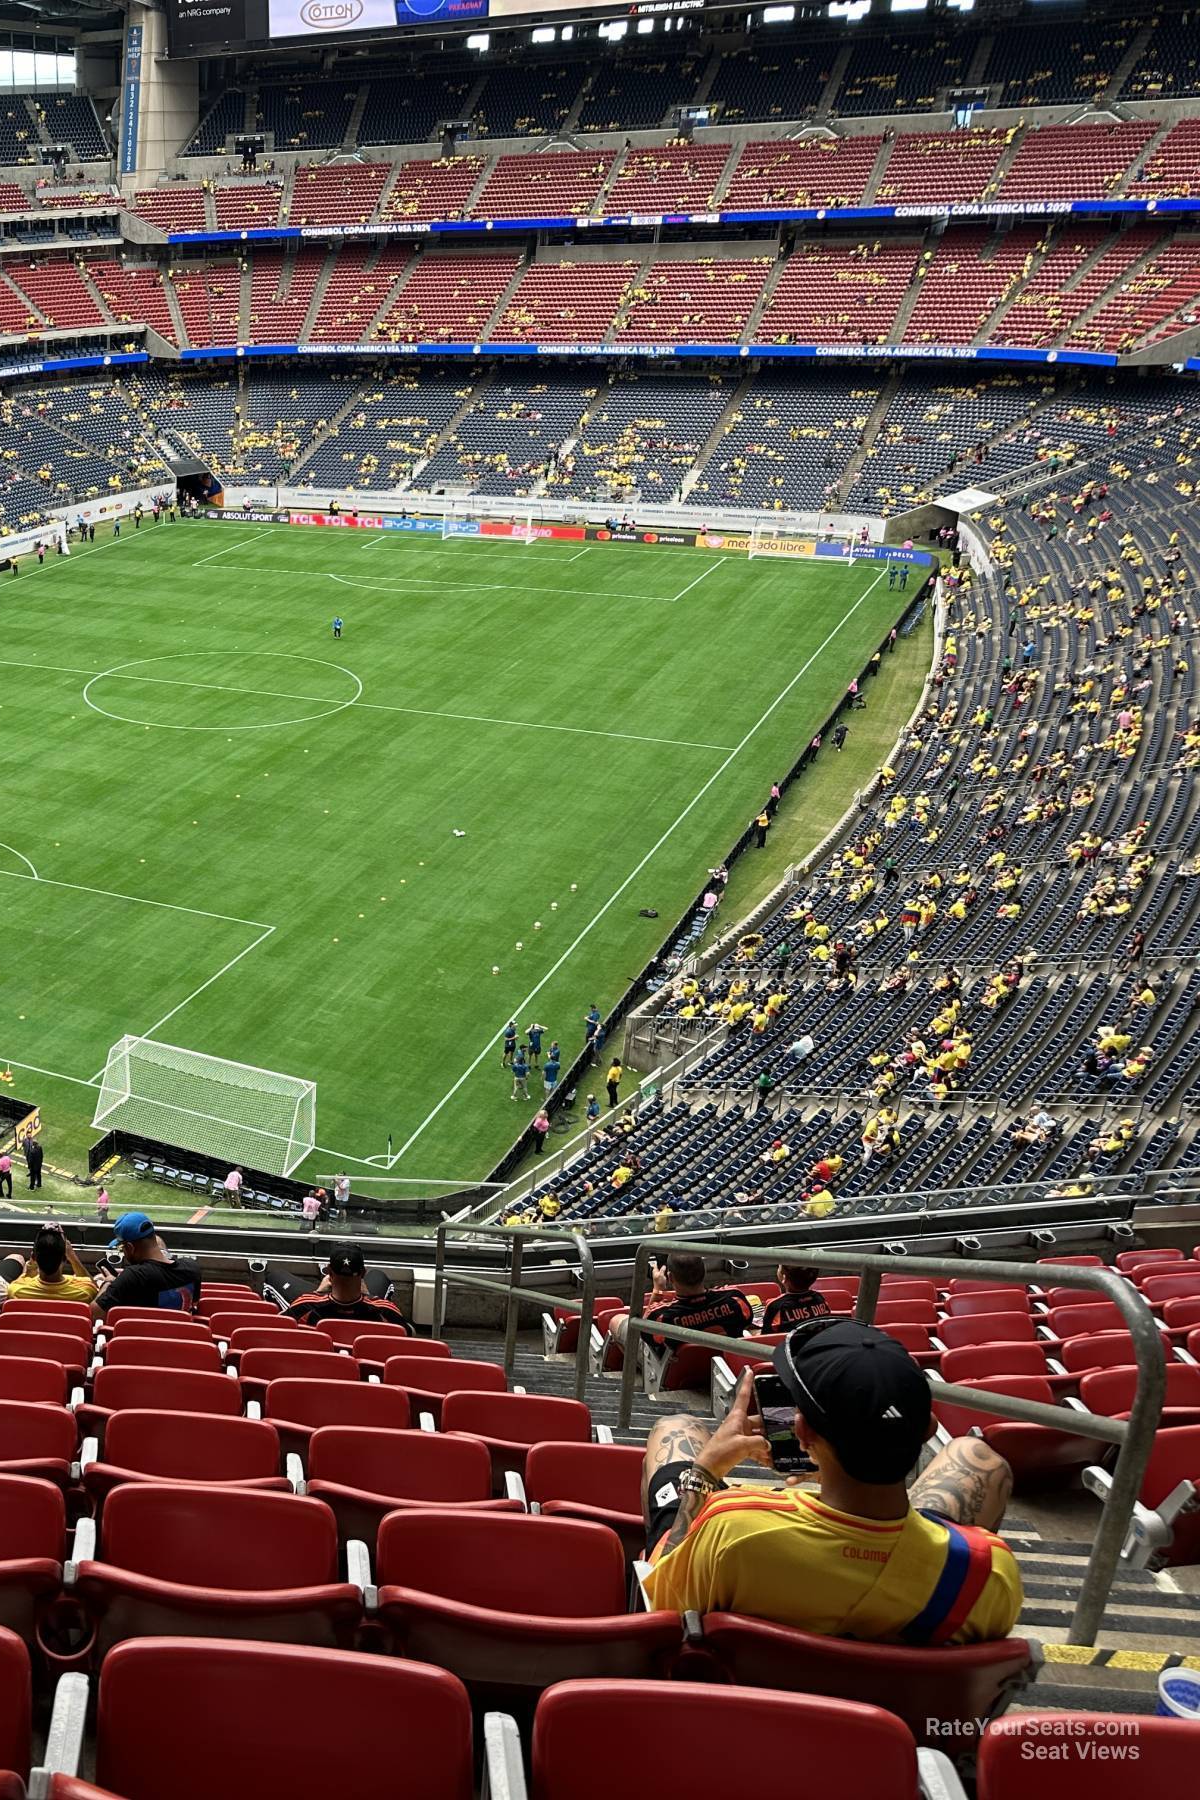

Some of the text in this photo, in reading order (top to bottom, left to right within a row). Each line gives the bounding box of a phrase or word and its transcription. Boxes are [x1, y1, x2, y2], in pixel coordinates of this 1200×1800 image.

[187, 8, 201, 17] NRG
[202, 7, 231, 16] company
[895, 203, 1073, 217] CONMEBOL COPA AMERICA USA 2024
[301, 227, 343, 236] CONMEBOL
[344, 226, 365, 235] COPA
[365, 225, 397, 234] AMERICA
[412, 224, 430, 232] 2024
[537, 346, 675, 354] CONMEBOL COPA AMERICA USA 2024
[816, 347, 977, 357] CONMEBOL COPA AMERICA USA 2024
[222, 511, 251, 521] ABSOLUT
[251, 513, 273, 522] SPORT
[290, 514, 316, 525] TCL
[323, 515, 349, 526] TCL
[356, 517, 383, 528] TCL
[384, 520, 413, 529] BYD
[416, 521, 445, 530] BYD
[448, 523, 478, 532] BYD
[780, 542, 806, 552] libre
[673, 1303, 735, 1326] CARRASCAL
[785, 1307, 810, 1322] LUIS
